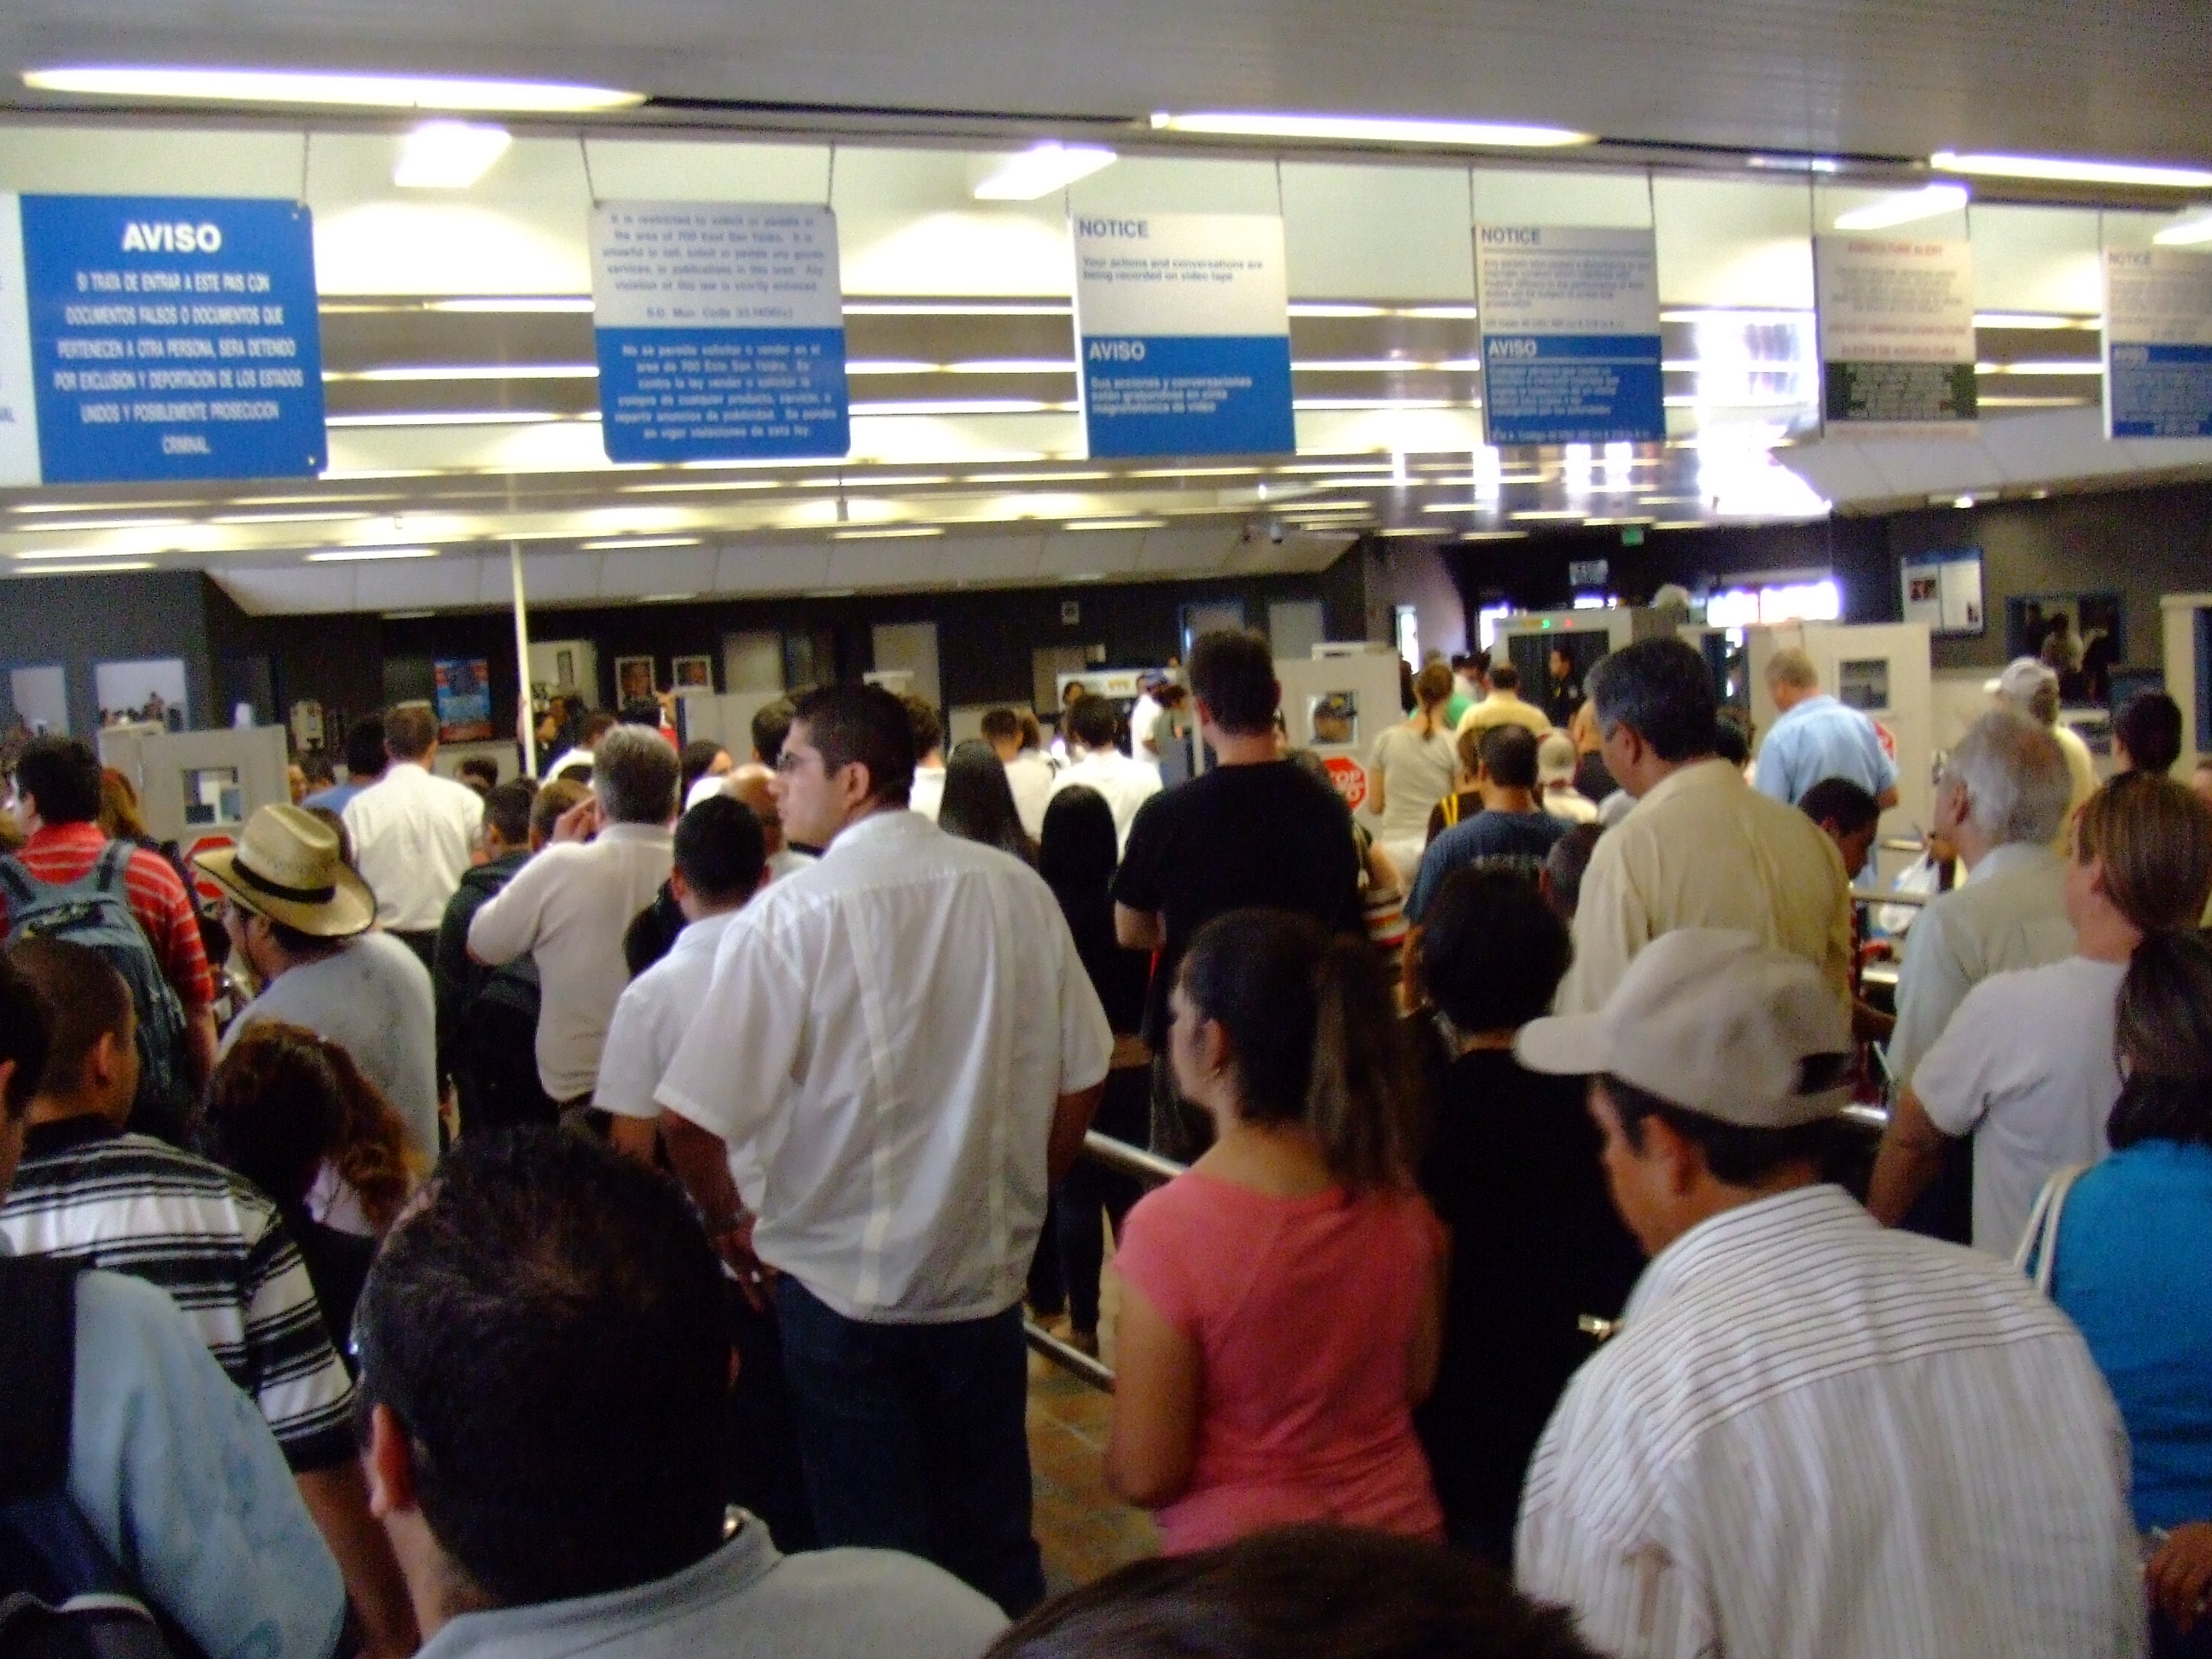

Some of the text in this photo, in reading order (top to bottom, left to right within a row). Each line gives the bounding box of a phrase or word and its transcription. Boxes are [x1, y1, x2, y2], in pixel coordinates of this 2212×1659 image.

[122, 222, 222, 253] AVISO
[1079, 219, 1149, 238] NOTICE
[1481, 229, 1540, 243] NOTICE
[1083, 259, 1263, 269] Your actions and conversations are
[90, 271, 122, 293] TRATA
[123, 271, 139, 292] DE
[142, 272, 181, 292] ENTRAR
[183, 272, 192, 292] A
[195, 272, 220, 292] ESTE
[247, 272, 271, 292] CON
[1083, 271, 1112, 281] being
[1115, 271, 1161, 281] recorded
[1165, 271, 1178, 281] on
[1181, 271, 1208, 281] video
[65, 306, 284, 325] DOCUMENTOS FALSOS O DOCUMENTOS QUE
[126, 339, 135, 358] A
[137, 339, 165, 358] OTRA
[1089, 341, 1145, 361] AVISO
[1488, 339, 1537, 357] AVISO
[53, 371, 77, 390] POR
[218, 369, 234, 388] DE
[236, 369, 256, 388] LOS
[259, 369, 304, 387] ESTADOS
